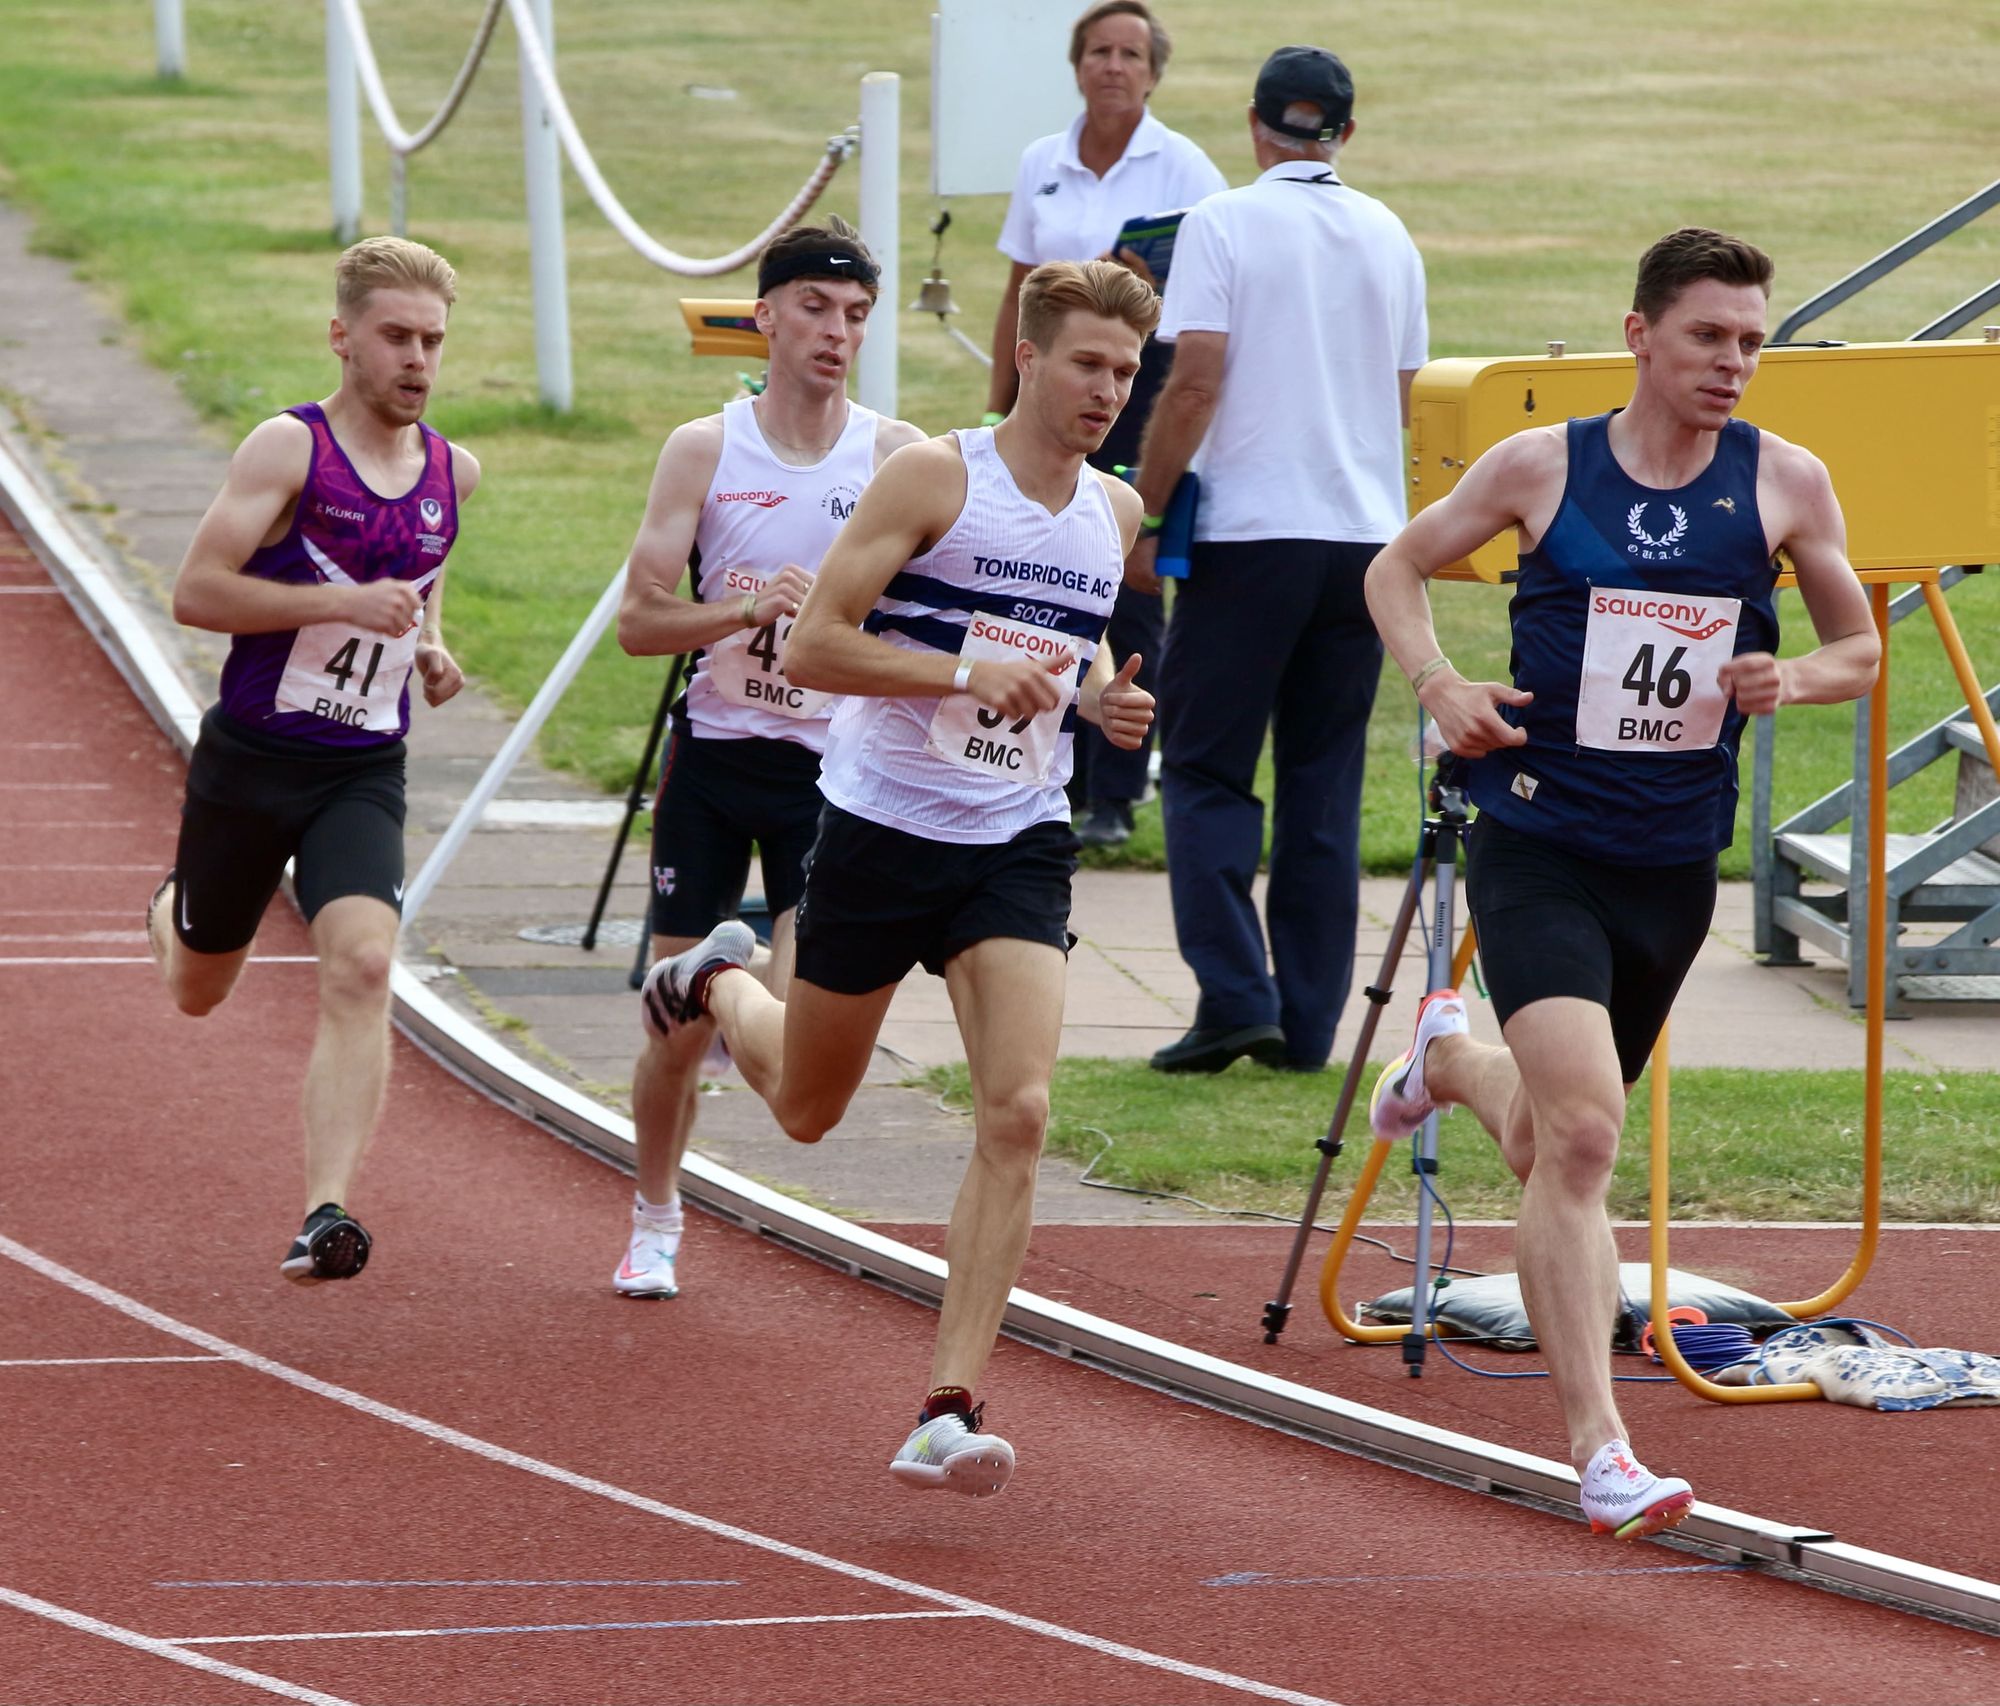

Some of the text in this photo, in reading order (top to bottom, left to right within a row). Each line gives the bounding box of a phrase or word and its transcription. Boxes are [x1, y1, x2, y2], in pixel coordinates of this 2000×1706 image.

[716, 491, 773, 503] saucony
[325, 504, 366, 522] KUKRI
[973, 556, 1112, 600] TONBRIDGE AC
[1009, 602, 1068, 628] soar
[1594, 596, 1708, 626] saucony
[747, 620, 790, 676] 4
[324, 637, 385, 697] 41
[1622, 643, 1692, 709] 46
[745, 678, 805, 709] BMC
[312, 697, 368, 729] BMC
[1618, 717, 1684, 742] BMC
[963, 736, 1024, 770] BMC
